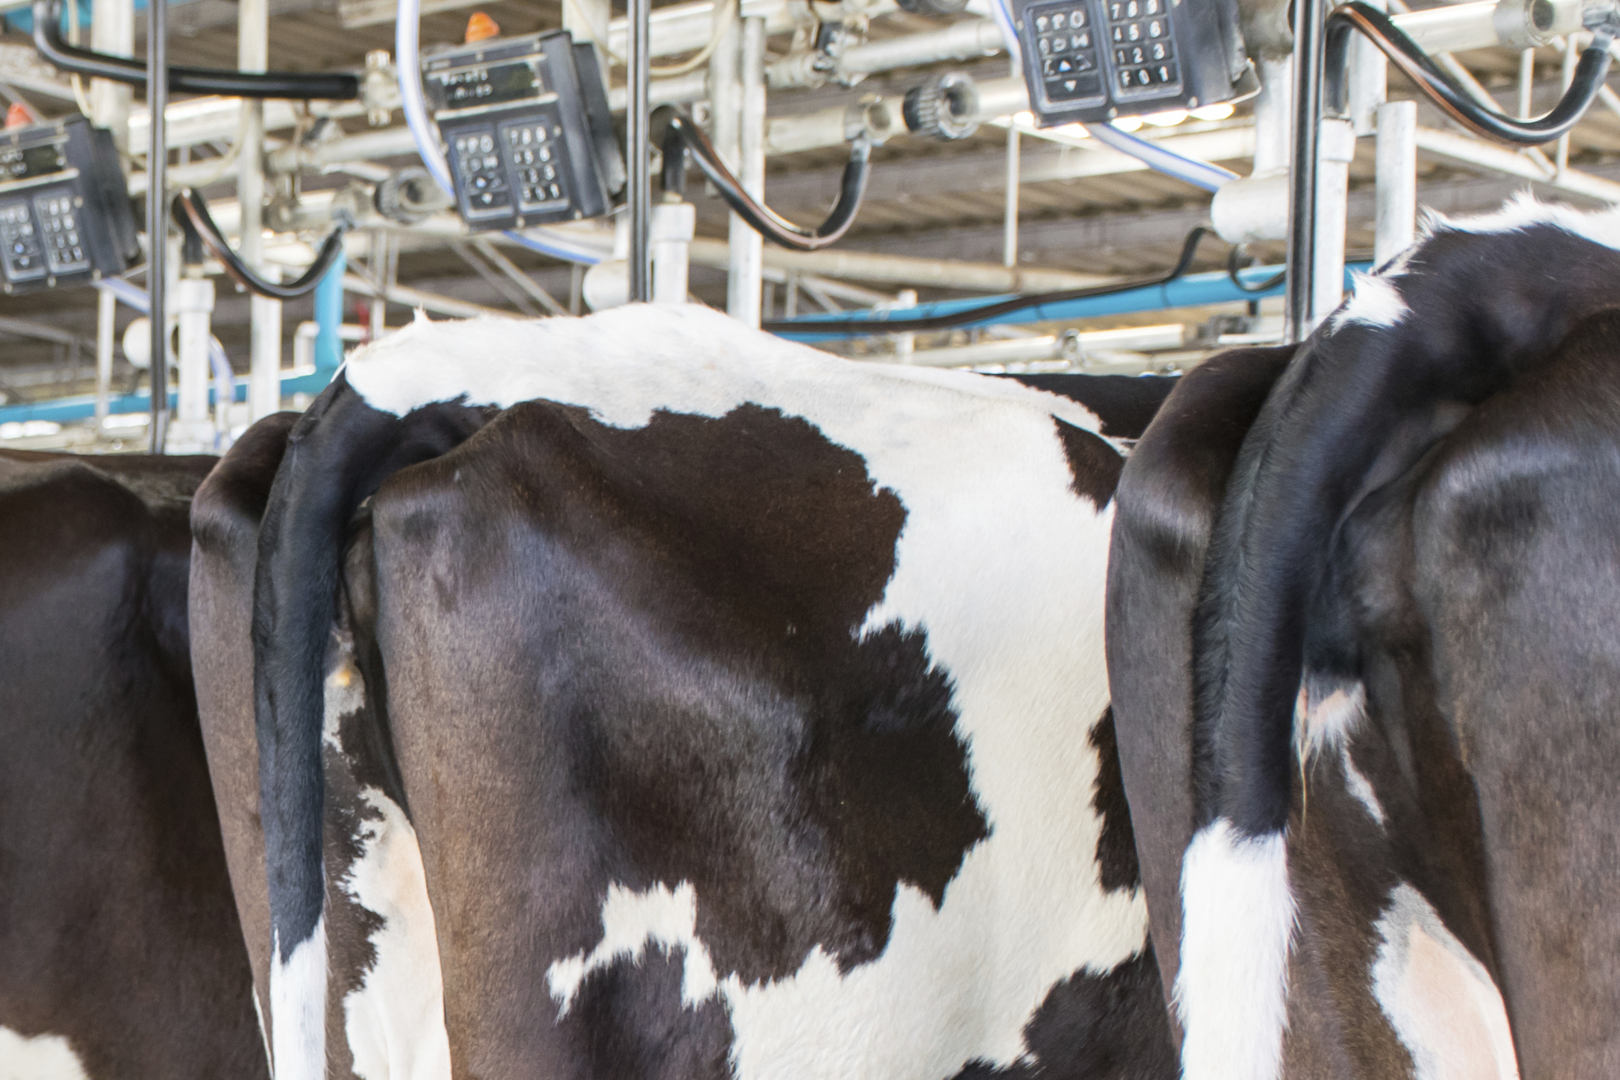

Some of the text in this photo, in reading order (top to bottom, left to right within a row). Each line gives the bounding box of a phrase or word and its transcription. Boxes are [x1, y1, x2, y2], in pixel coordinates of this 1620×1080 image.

[1112, 3, 1120, 20] 7
[1127, 0, 1137, 17] 8
[1114, 20, 1161, 42] 4 5 6
[1118, 43, 1165, 65] 1 2 3
